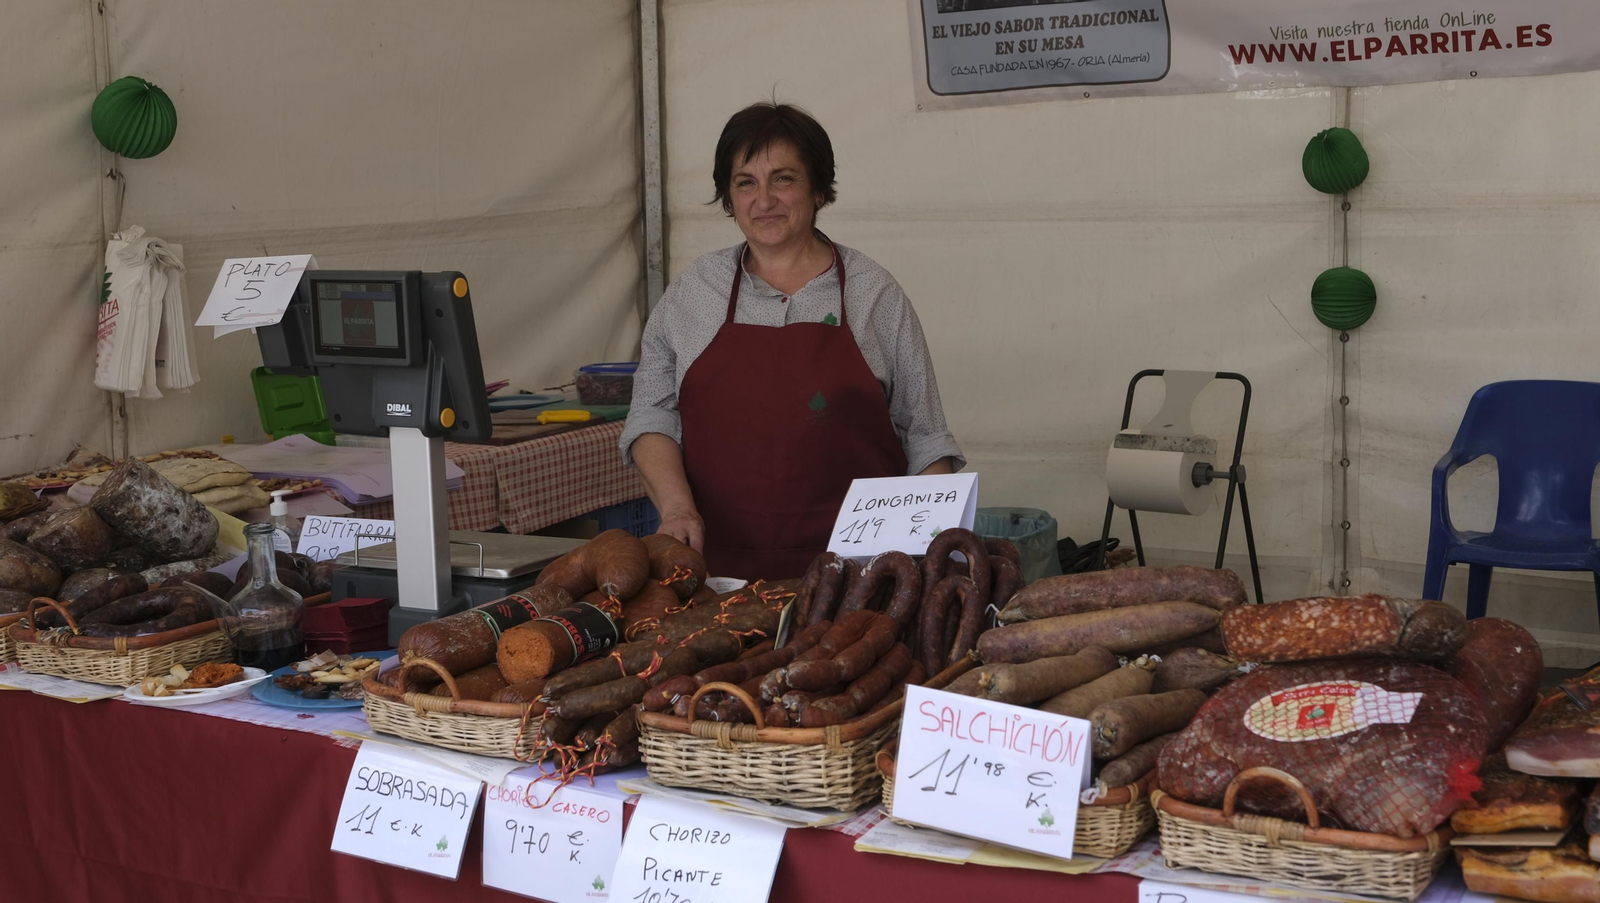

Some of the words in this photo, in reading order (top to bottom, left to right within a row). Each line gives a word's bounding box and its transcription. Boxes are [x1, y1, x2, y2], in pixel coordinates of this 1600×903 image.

[932, 25, 948, 39] EL
[951, 22, 990, 38] VIEJO
[995, 18, 1044, 34] SABOR
[1049, 9, 1159, 30] TRADICIONAL
[1270, 26, 1308, 41] Visita
[1318, 21, 1374, 38] nuestra
[1384, 16, 1430, 32] tienda
[1440, 11, 1496, 28] OnLine
[995, 41, 1015, 56] EN
[1019, 40, 1038, 53] SU
[1042, 35, 1084, 51] MESA
[1228, 24, 1553, 65] WWW.ELPARRITA.ES
[951, 64, 978, 76] CASA
[979, 60, 1028, 76] FUNDADA
[1029, 58, 1044, 70] EN
[1078, 54, 1106, 67] ORIA
[1108, 52, 1150, 66] (Almería)
[225, 260, 291, 288] PLATO
[236, 280, 265, 300] 5
[387, 404, 412, 412] DIBAL
[852, 490, 956, 512] LONGANIZA
[304, 518, 395, 542] BUTIFARRA
[920, 700, 1084, 766] SALCHICHÓN
[355, 766, 468, 820] SOBRASADA
[346, 804, 382, 835] 11
[552, 802, 610, 823] CASERO
[506, 819, 550, 854] 9'70
[650, 823, 731, 844] CHORIZO
[644, 856, 722, 886] PICANTE
[633, 886, 691, 903] 10'7
